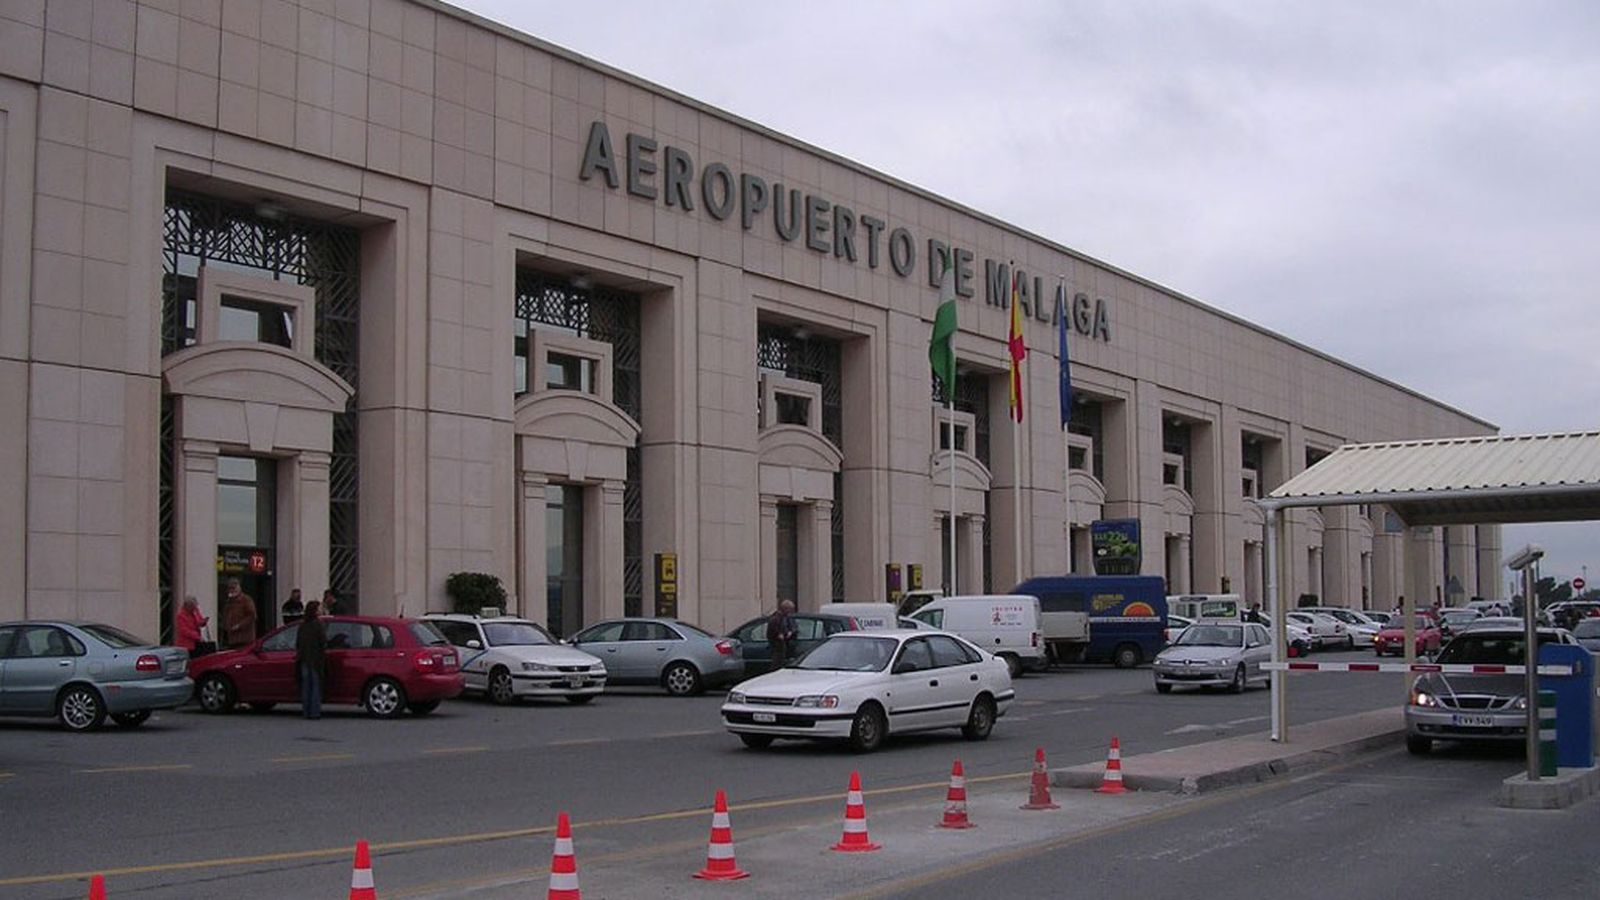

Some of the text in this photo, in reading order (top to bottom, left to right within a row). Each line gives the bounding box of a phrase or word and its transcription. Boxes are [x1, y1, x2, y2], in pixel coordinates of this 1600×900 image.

[579, 121, 1111, 342] AEROPUERTO DE MALAGA
[251, 555, 265, 568] T2
